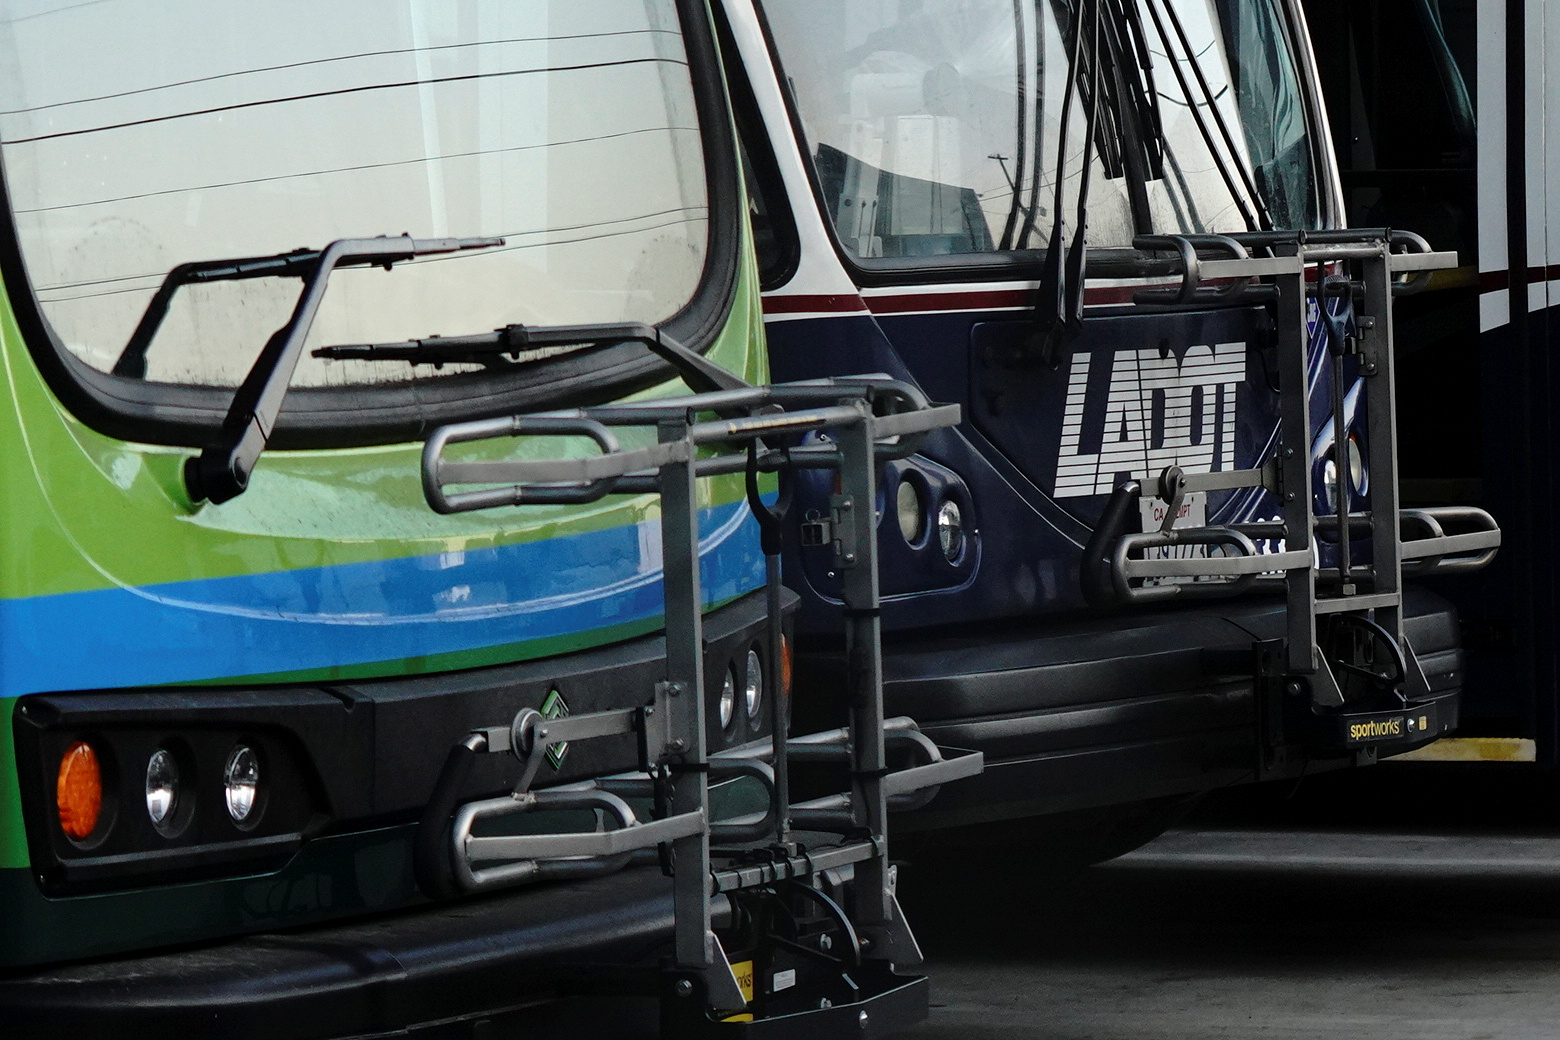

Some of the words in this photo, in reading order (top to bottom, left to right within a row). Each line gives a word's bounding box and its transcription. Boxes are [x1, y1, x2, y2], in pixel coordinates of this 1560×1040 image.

[1053, 341, 1247, 499] LADOT
[1153, 508, 1164, 521] CA
[1350, 719, 1400, 741] sportworks
